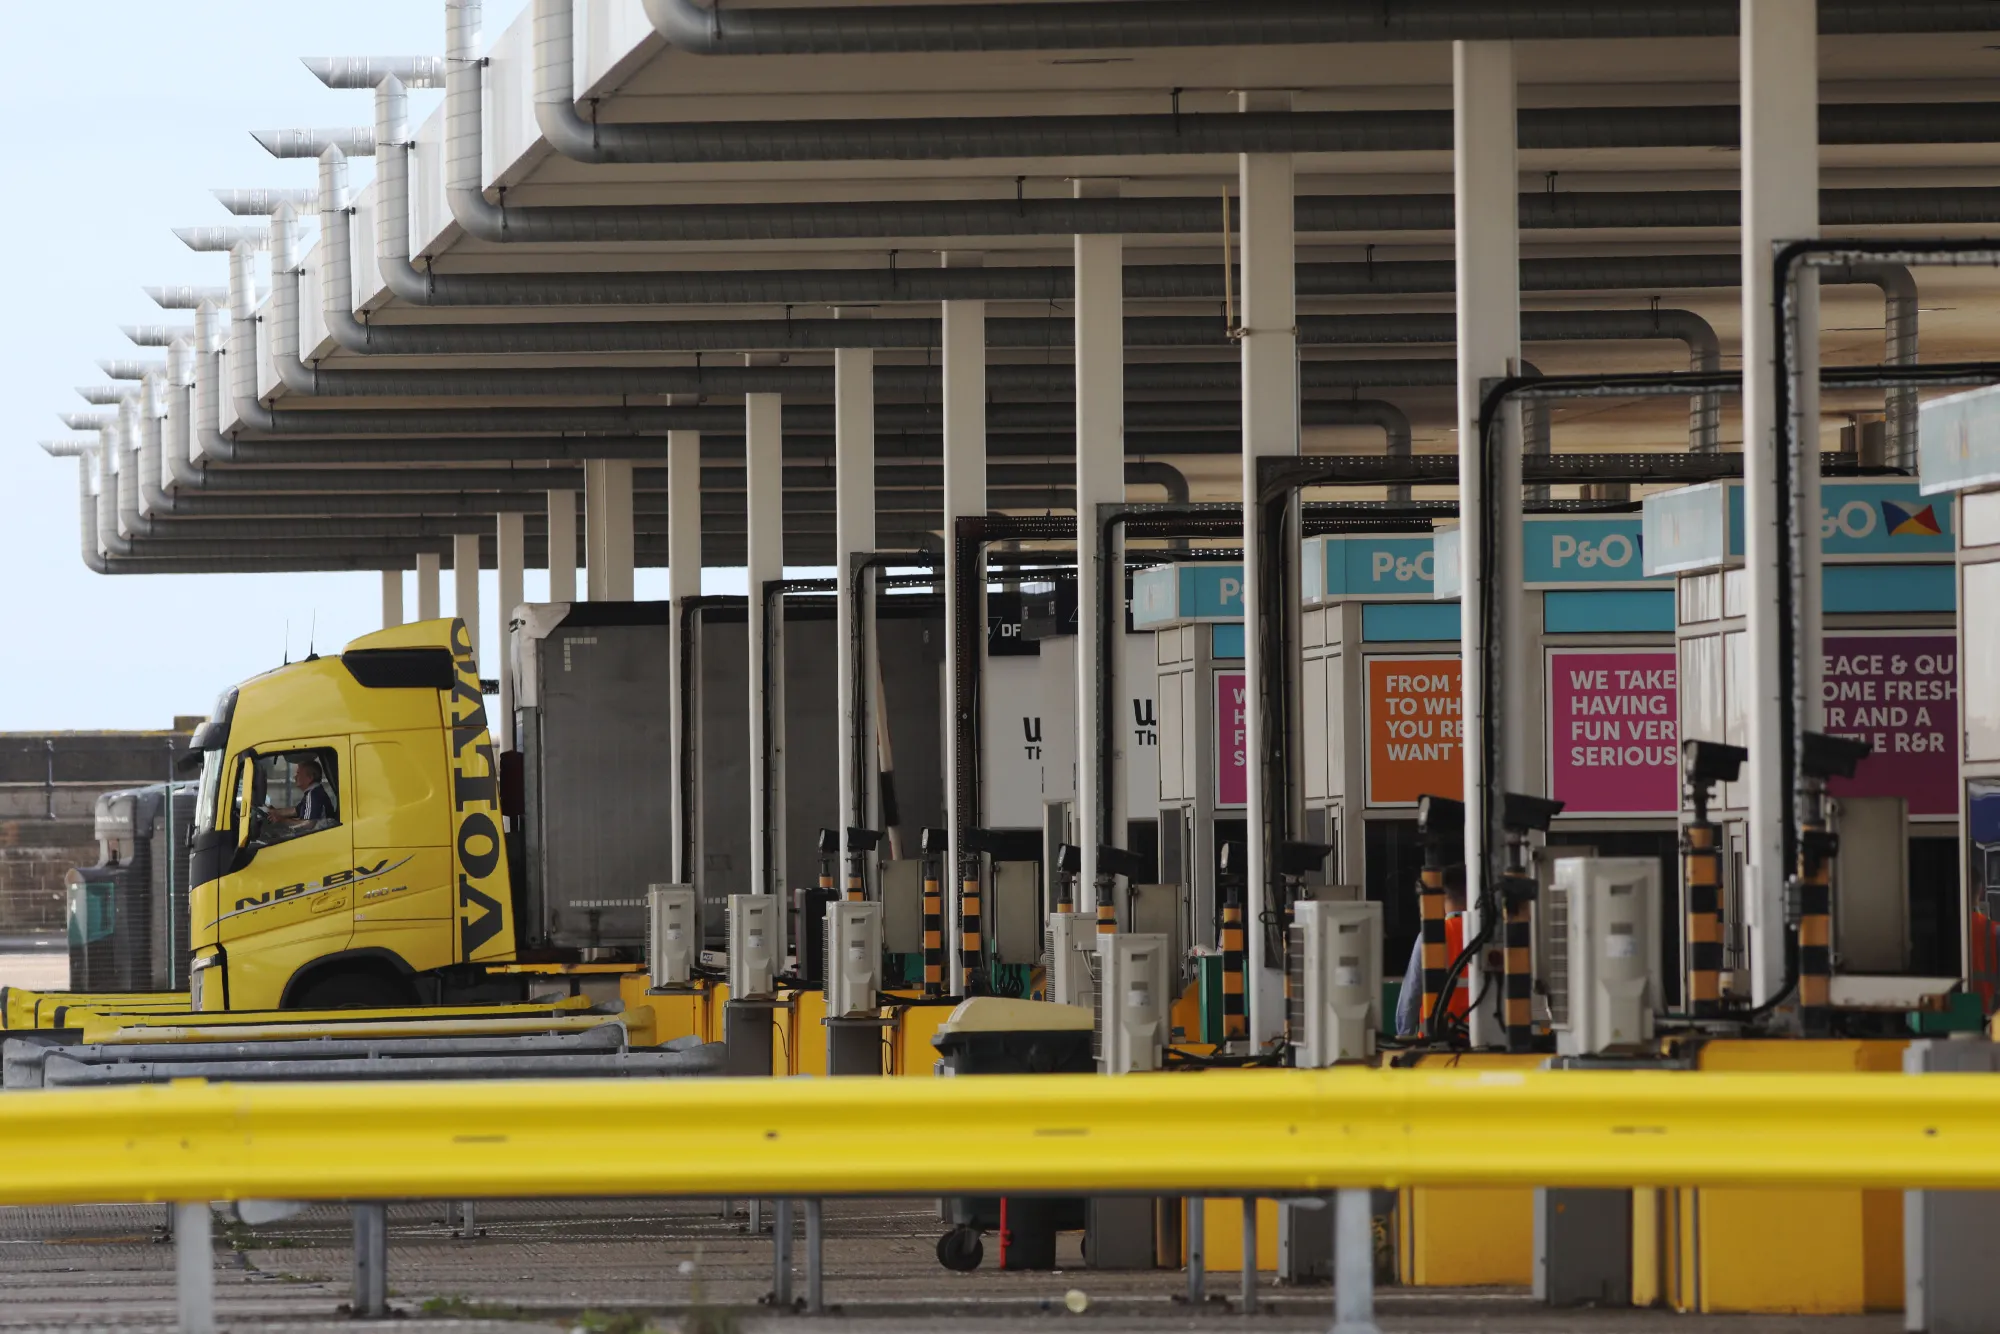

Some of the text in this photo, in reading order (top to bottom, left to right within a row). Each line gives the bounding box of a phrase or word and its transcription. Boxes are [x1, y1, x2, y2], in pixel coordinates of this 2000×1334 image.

[1552, 534, 1633, 568] P&O
[1220, 578, 1244, 605] P
[1891, 655, 1908, 675] &
[1914, 654, 1954, 674] QU
[1386, 675, 1450, 692] FROM
[1570, 669, 1676, 690] WE TAKE
[1385, 697, 1461, 715] TO WH
[1571, 695, 1668, 715] HAVING
[1853, 707, 1908, 727] AND
[1914, 706, 1932, 727] A
[1385, 720, 1433, 738] YOU
[1572, 720, 1678, 740] FUN VER
[1386, 743, 1454, 761] WANT
[1894, 732, 1945, 753] R&R
[1571, 745, 1677, 766] SERIOUS
[451, 617, 504, 963] VOLVO
